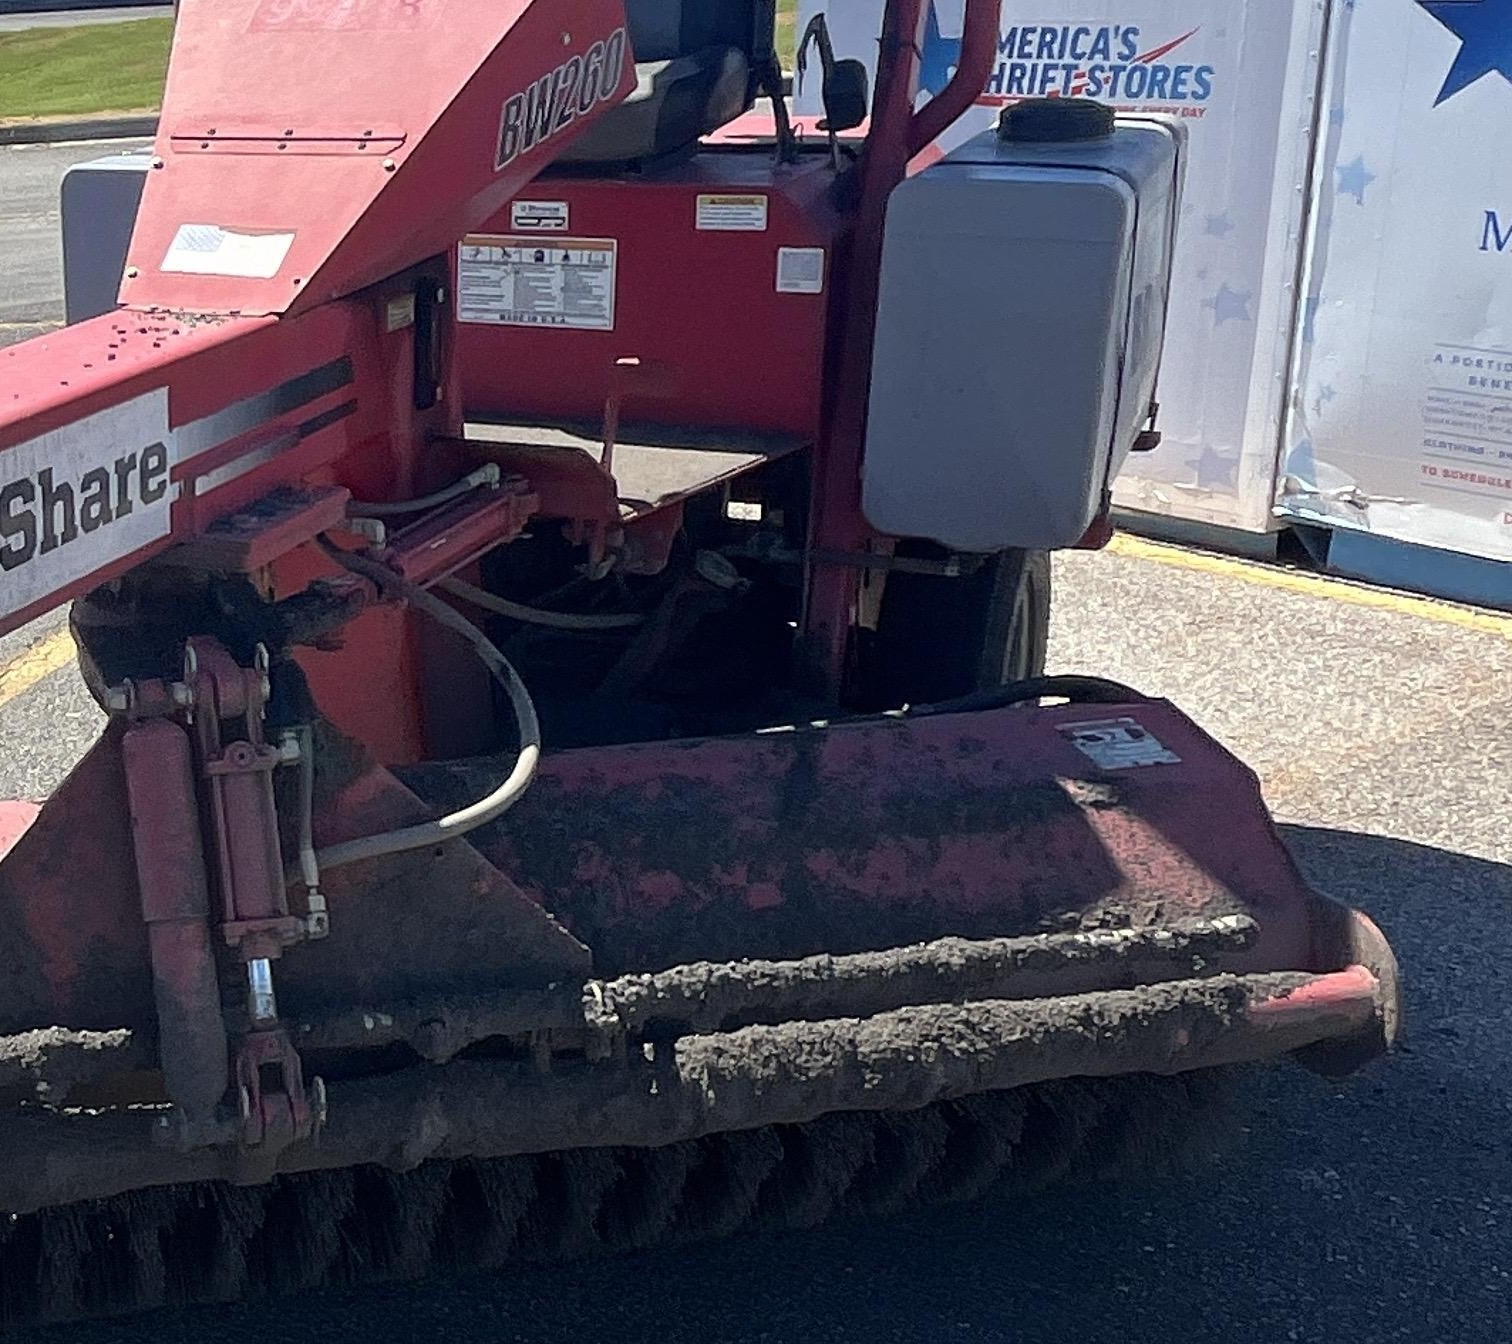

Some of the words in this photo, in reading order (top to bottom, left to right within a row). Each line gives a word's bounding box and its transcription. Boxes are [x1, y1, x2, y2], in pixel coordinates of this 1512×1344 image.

[998, 25, 1139, 62] MERICA'S
[494, 27, 626, 172] BW260
[985, 62, 1080, 95] HRIFT
[1085, 64, 1216, 101] STORES
